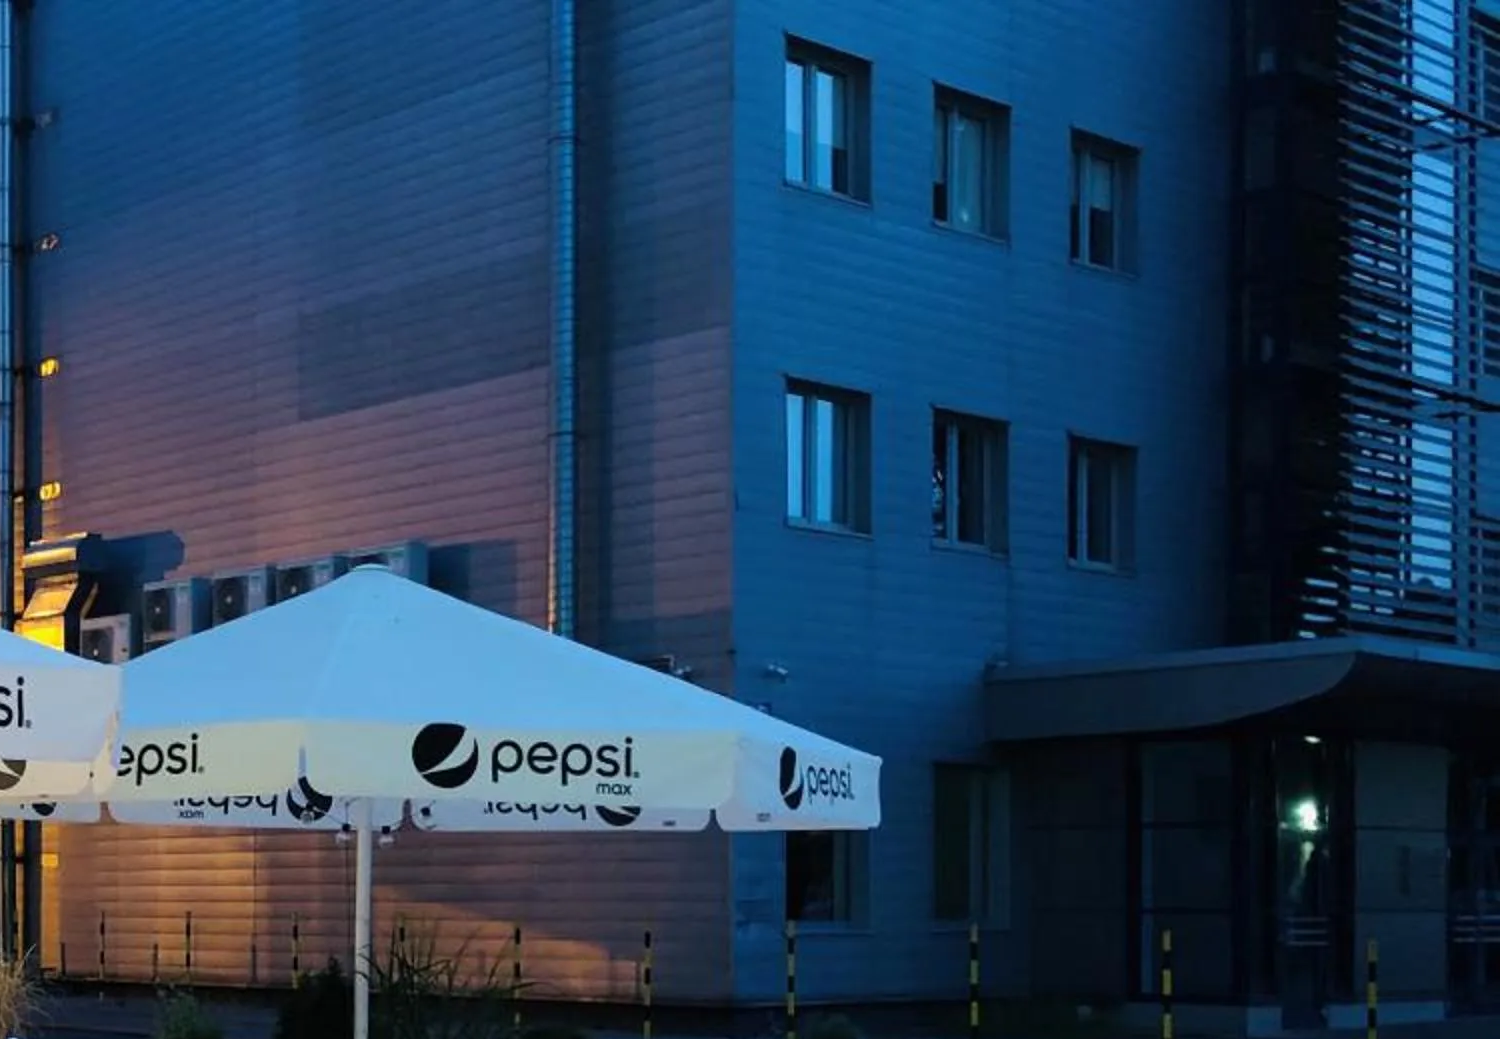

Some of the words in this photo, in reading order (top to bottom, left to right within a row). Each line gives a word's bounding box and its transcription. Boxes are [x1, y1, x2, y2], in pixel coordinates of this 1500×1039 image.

[117, 733, 199, 786] epsi
[492, 737, 633, 786] pepsi
[596, 783, 632, 795] max
[807, 763, 853, 804] pepsi
